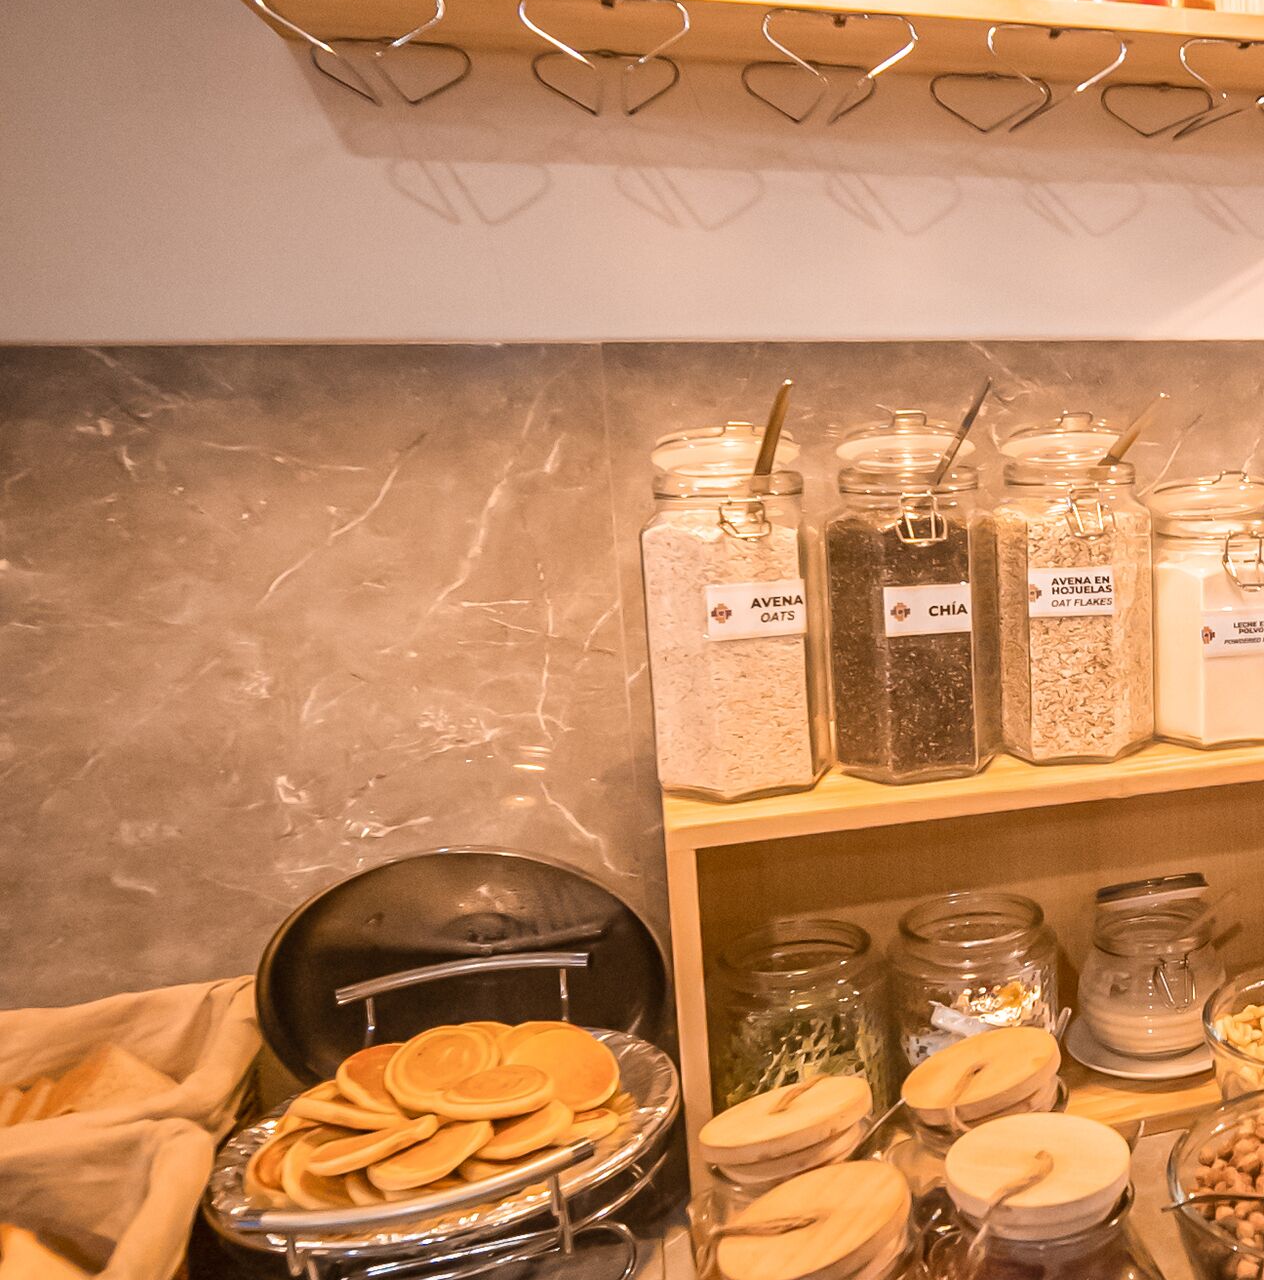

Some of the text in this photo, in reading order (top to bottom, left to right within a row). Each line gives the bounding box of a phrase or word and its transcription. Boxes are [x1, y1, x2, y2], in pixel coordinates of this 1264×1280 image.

[1051, 575, 1110, 586] AVENA EN
[1051, 584, 1113, 595] HOJUELAS
[751, 594, 804, 610] AVENA
[1051, 597, 1113, 608] OAT FLAKES
[928, 600, 968, 617] CHÍA
[760, 610, 795, 623] OATS
[1233, 620, 1258, 629] LECHE
